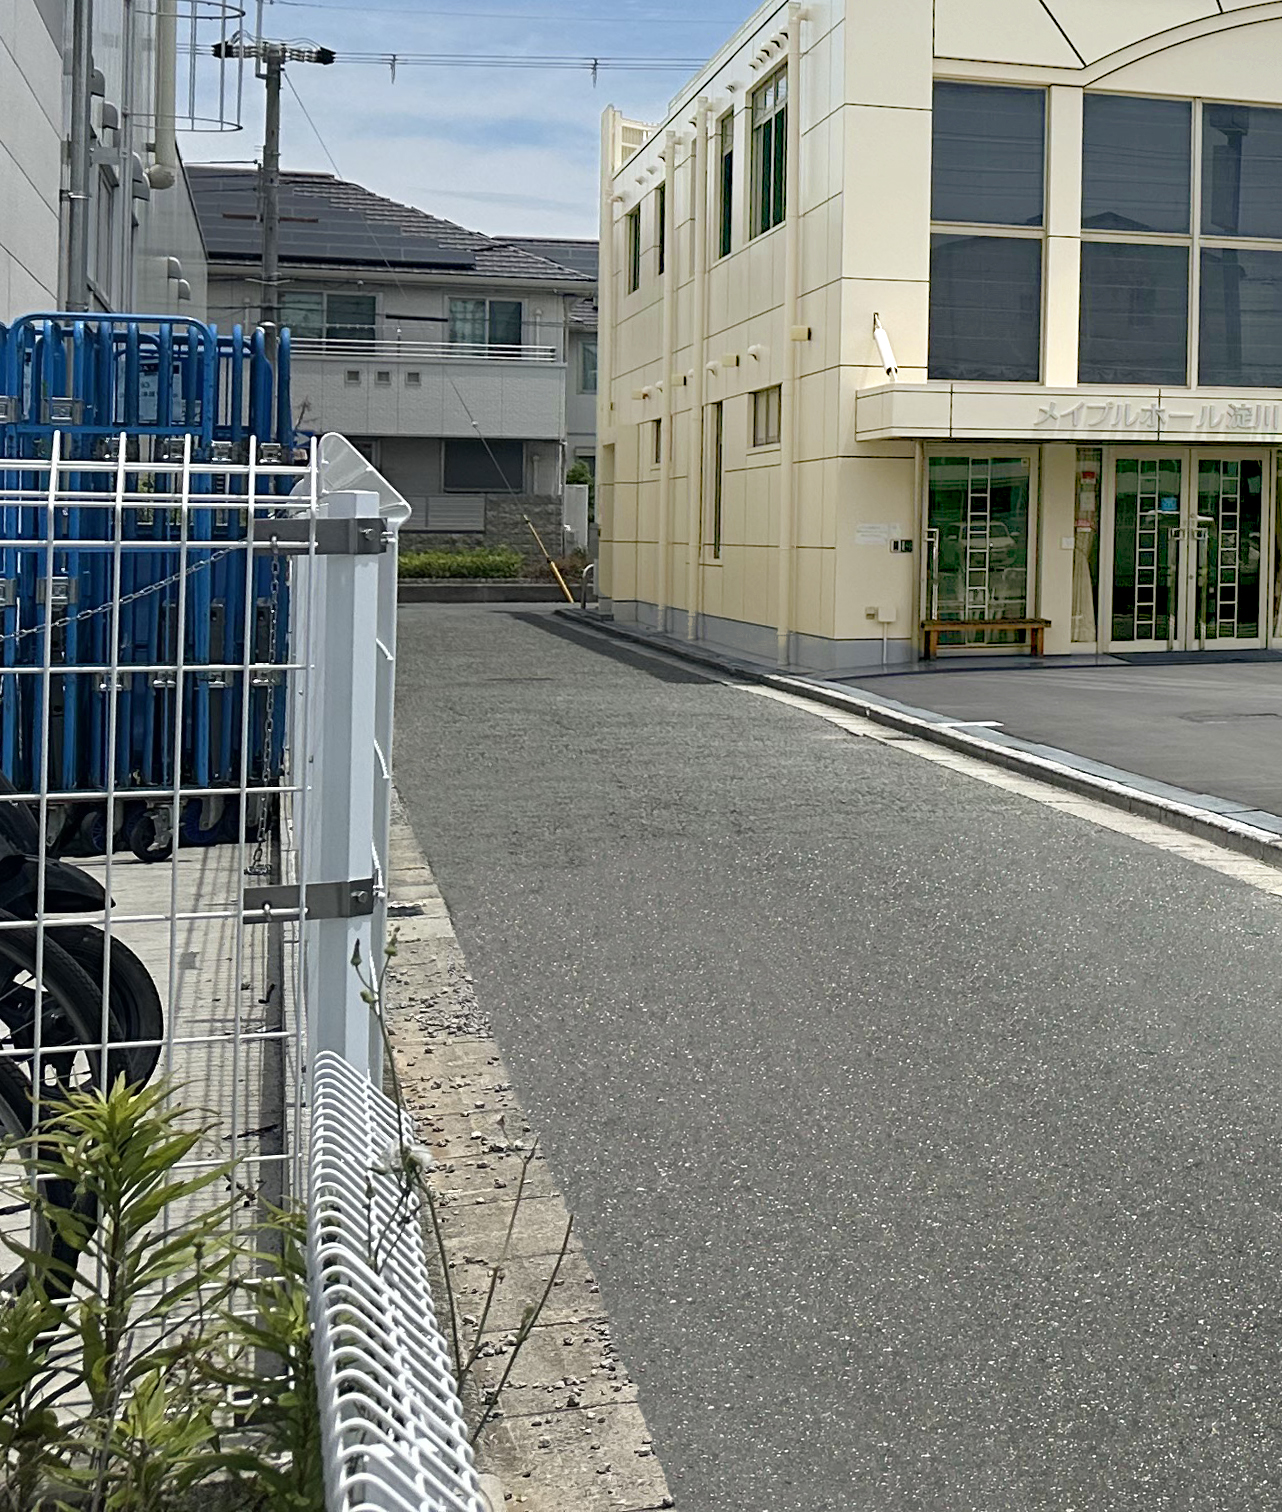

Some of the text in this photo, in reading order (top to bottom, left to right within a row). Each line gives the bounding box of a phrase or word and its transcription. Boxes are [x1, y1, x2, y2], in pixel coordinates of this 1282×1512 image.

[1033, 401, 1280, 431] メイプルホール淀川
